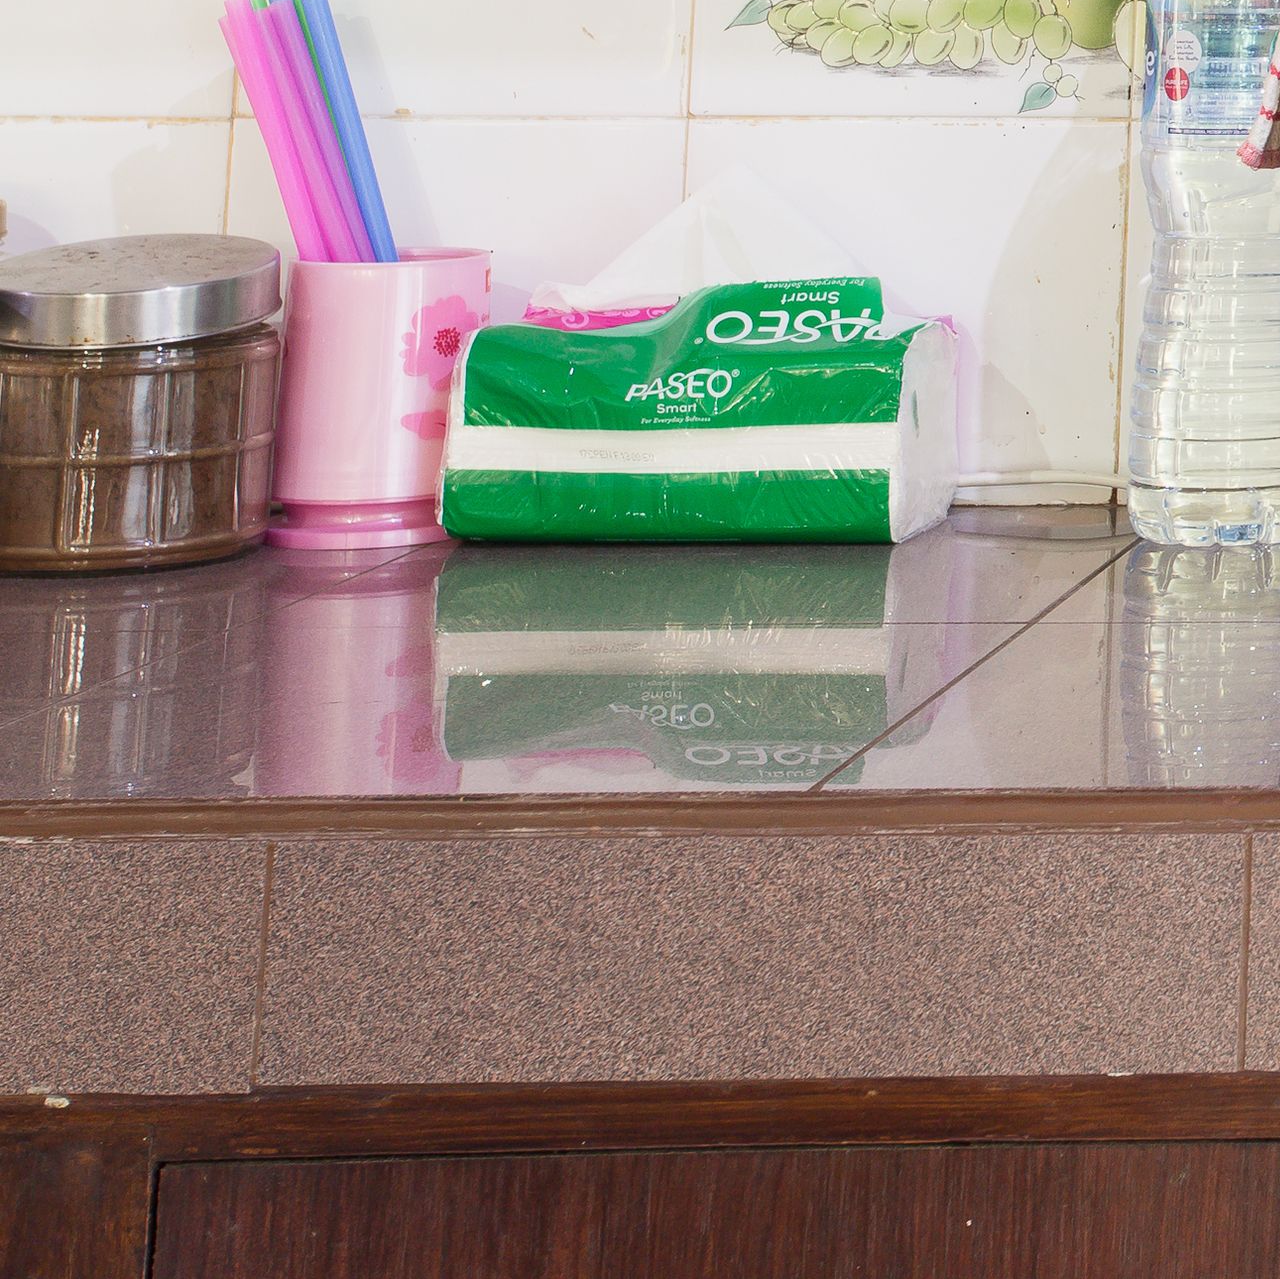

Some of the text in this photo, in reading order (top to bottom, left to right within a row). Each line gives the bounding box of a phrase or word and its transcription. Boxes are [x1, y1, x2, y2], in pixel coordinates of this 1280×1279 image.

[780, 290, 841, 305] Smart
[624, 367, 733, 402] PASEO
[656, 402, 697, 415] Smart
